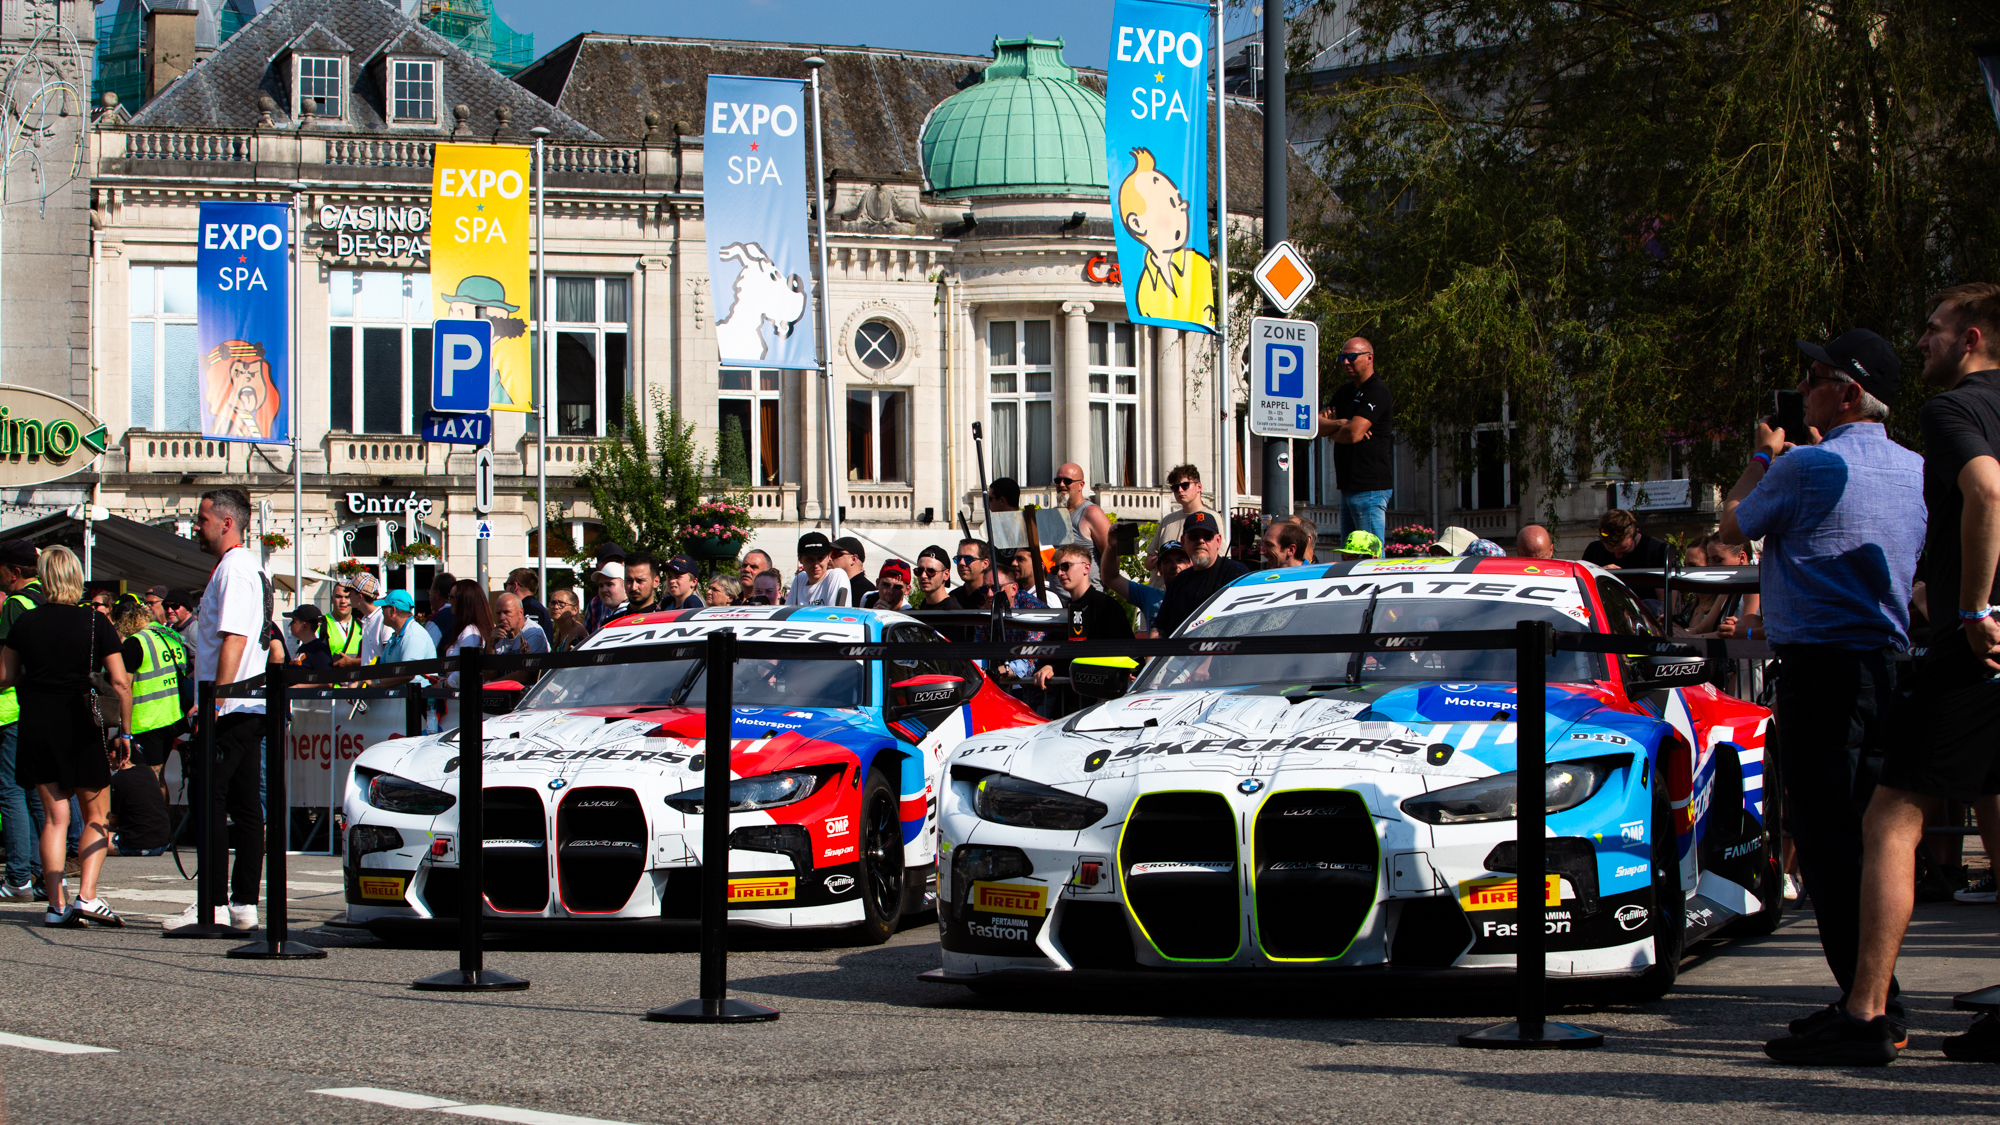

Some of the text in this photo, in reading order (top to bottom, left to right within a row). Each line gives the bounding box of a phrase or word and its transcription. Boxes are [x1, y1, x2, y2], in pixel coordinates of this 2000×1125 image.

[1116, 25, 1203, 68] EXPO
[1130, 86, 1189, 122] SPA
[711, 102, 798, 137] EXPO
[727, 155, 783, 186] SPA
[439, 168, 523, 199] EXPO
[319, 204, 431, 232] CASINO
[204, 223, 283, 251] EXPO
[454, 216, 507, 243] SPA
[337, 233, 425, 258] DE SPA
[218, 266, 268, 291] SPA
[1086, 255, 1123, 284] Ca
[1263, 325, 1306, 341] ZONE
[441, 333, 483, 396] P
[1272, 347, 1298, 392] P
[1261, 400, 1290, 409] RAPPEL
[0, 405, 81, 456] ino
[429, 416, 483, 440] TAXI
[345, 490, 433, 515] Entrée
[1220, 581, 1569, 613] FANATEC
[590, 625, 851, 647] FANATEC
[1199, 641, 1241, 651] WRT
[1383, 636, 1430, 648] WRT
[675, 646, 696, 657] WRT
[848, 646, 888, 656] WRT
[1019, 645, 1061, 655] WRT
[1075, 672, 1109, 686] WRT
[1655, 661, 1705, 677] WRT
[914, 688, 955, 702] WRT
[1444, 696, 1518, 710] Motorspo
[734, 717, 802, 729] Motorsport
[482, 749, 691, 763] KECHERS
[1108, 737, 1427, 763] SKECHERS
[1283, 805, 1345, 816] WRT
[826, 818, 849, 834] OMP
[1620, 824, 1645, 843] OMP
[824, 845, 854, 858] Snap-on
[1724, 835, 1762, 860] FANATEC
[1140, 860, 1232, 869] CROWDSTRIKE
[1615, 863, 1648, 878] Snap-on
[363, 880, 399, 896] PIRELLI
[728, 881, 789, 898] PIRELLI
[980, 886, 1041, 910] PIRELLI
[1468, 881, 1551, 905] PIREI
[967, 920, 1028, 941] Fastron
[991, 916, 1028, 928] PERTAMINA
[1483, 920, 1572, 938] Fason
